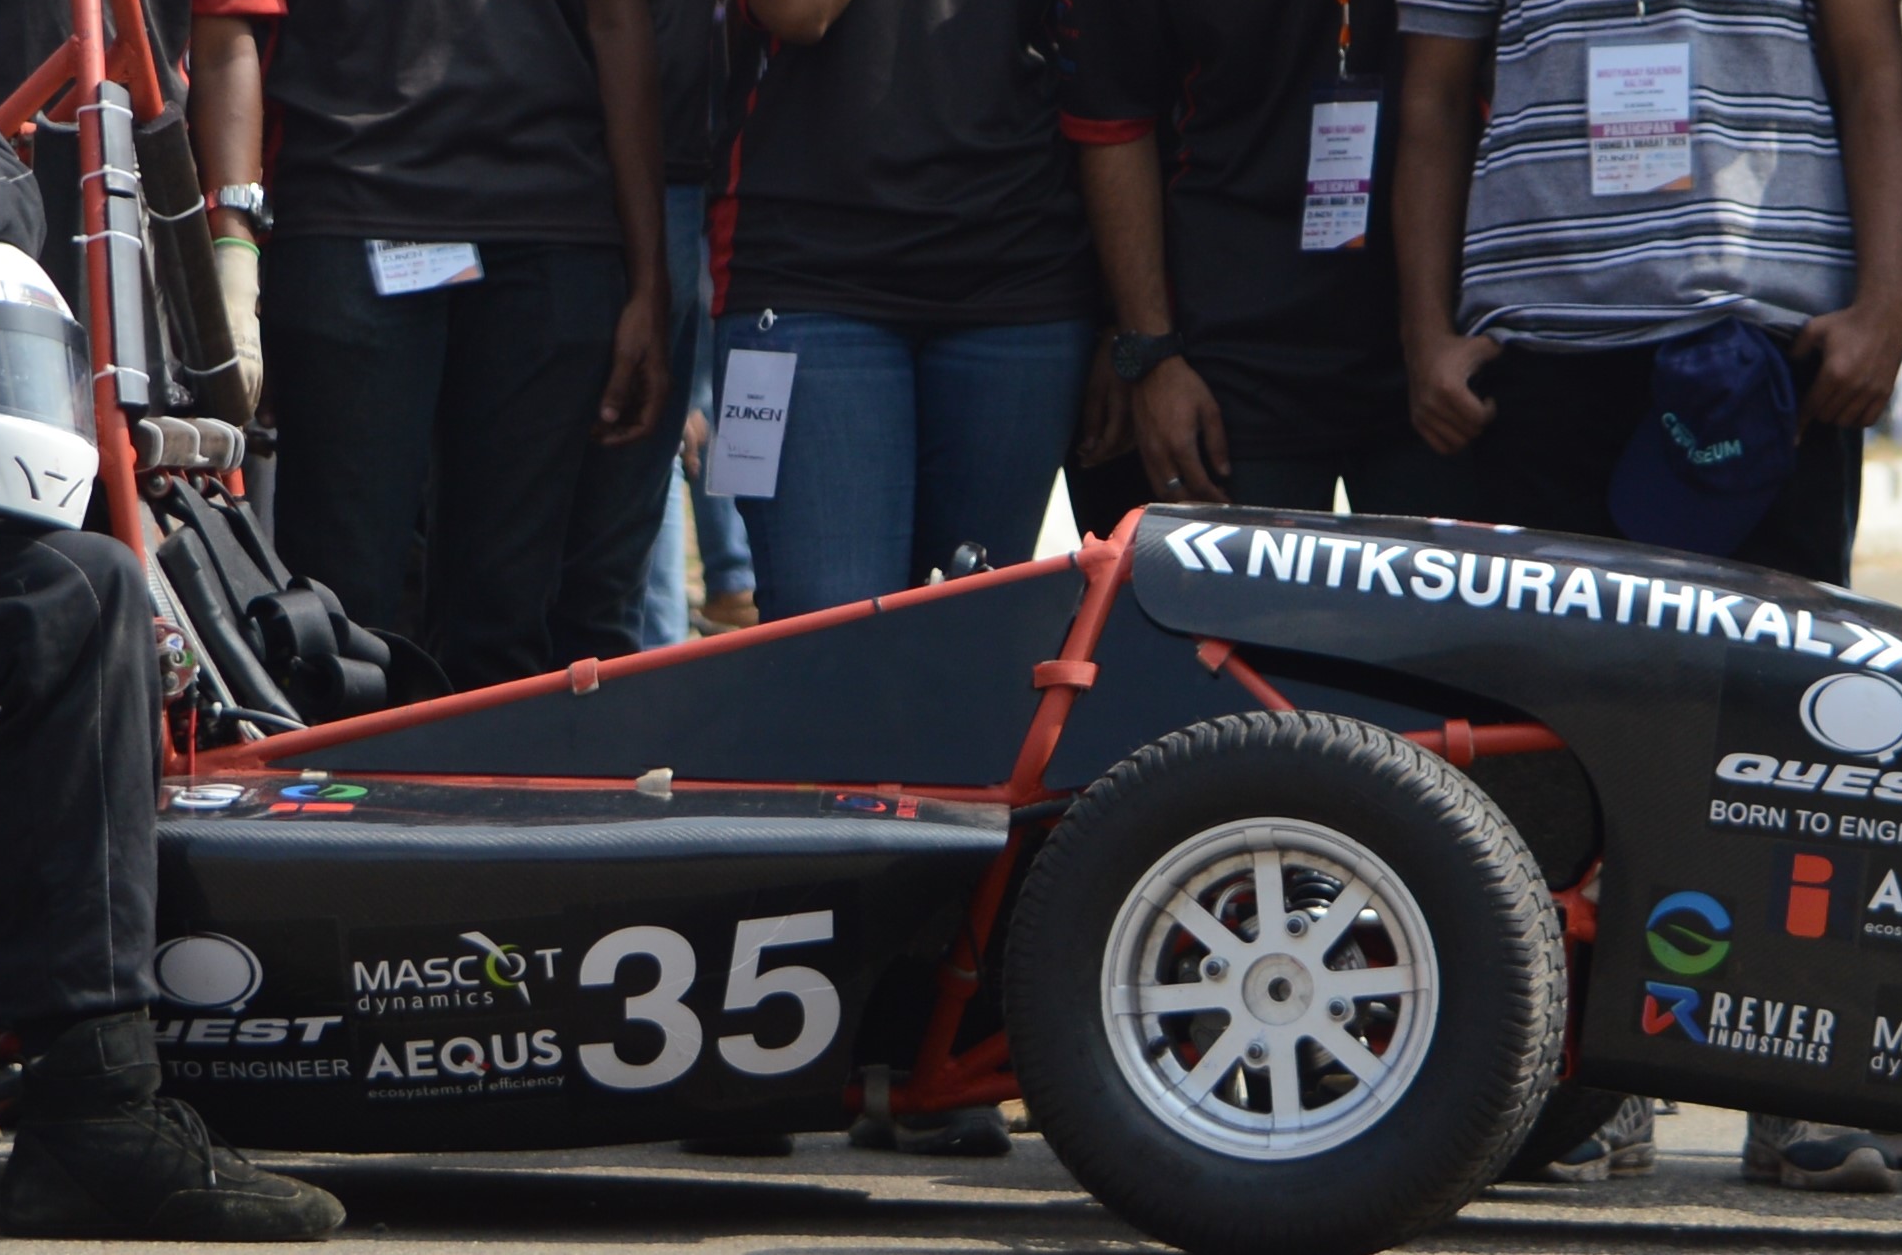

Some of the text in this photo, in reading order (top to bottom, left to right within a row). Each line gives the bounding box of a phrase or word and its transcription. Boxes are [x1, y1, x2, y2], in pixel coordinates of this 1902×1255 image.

[1603, 121, 1676, 137] PARTICIPANT
[725, 404, 784, 422] ZUKEN
[1709, 799, 1786, 830] BORN
[1794, 809, 1831, 834] TO
[353, 947, 563, 992] MASCOT
[357, 989, 495, 1015] dynamics
[576, 909, 842, 1092] 35
[1710, 991, 1835, 1044] REVER
[366, 1028, 564, 1080] AEQUS
[1707, 1025, 1831, 1064] INDUSTRIES
[167, 1057, 352, 1080] TO ENGINEER
[367, 1074, 566, 1101] ecosystems of efficiency
